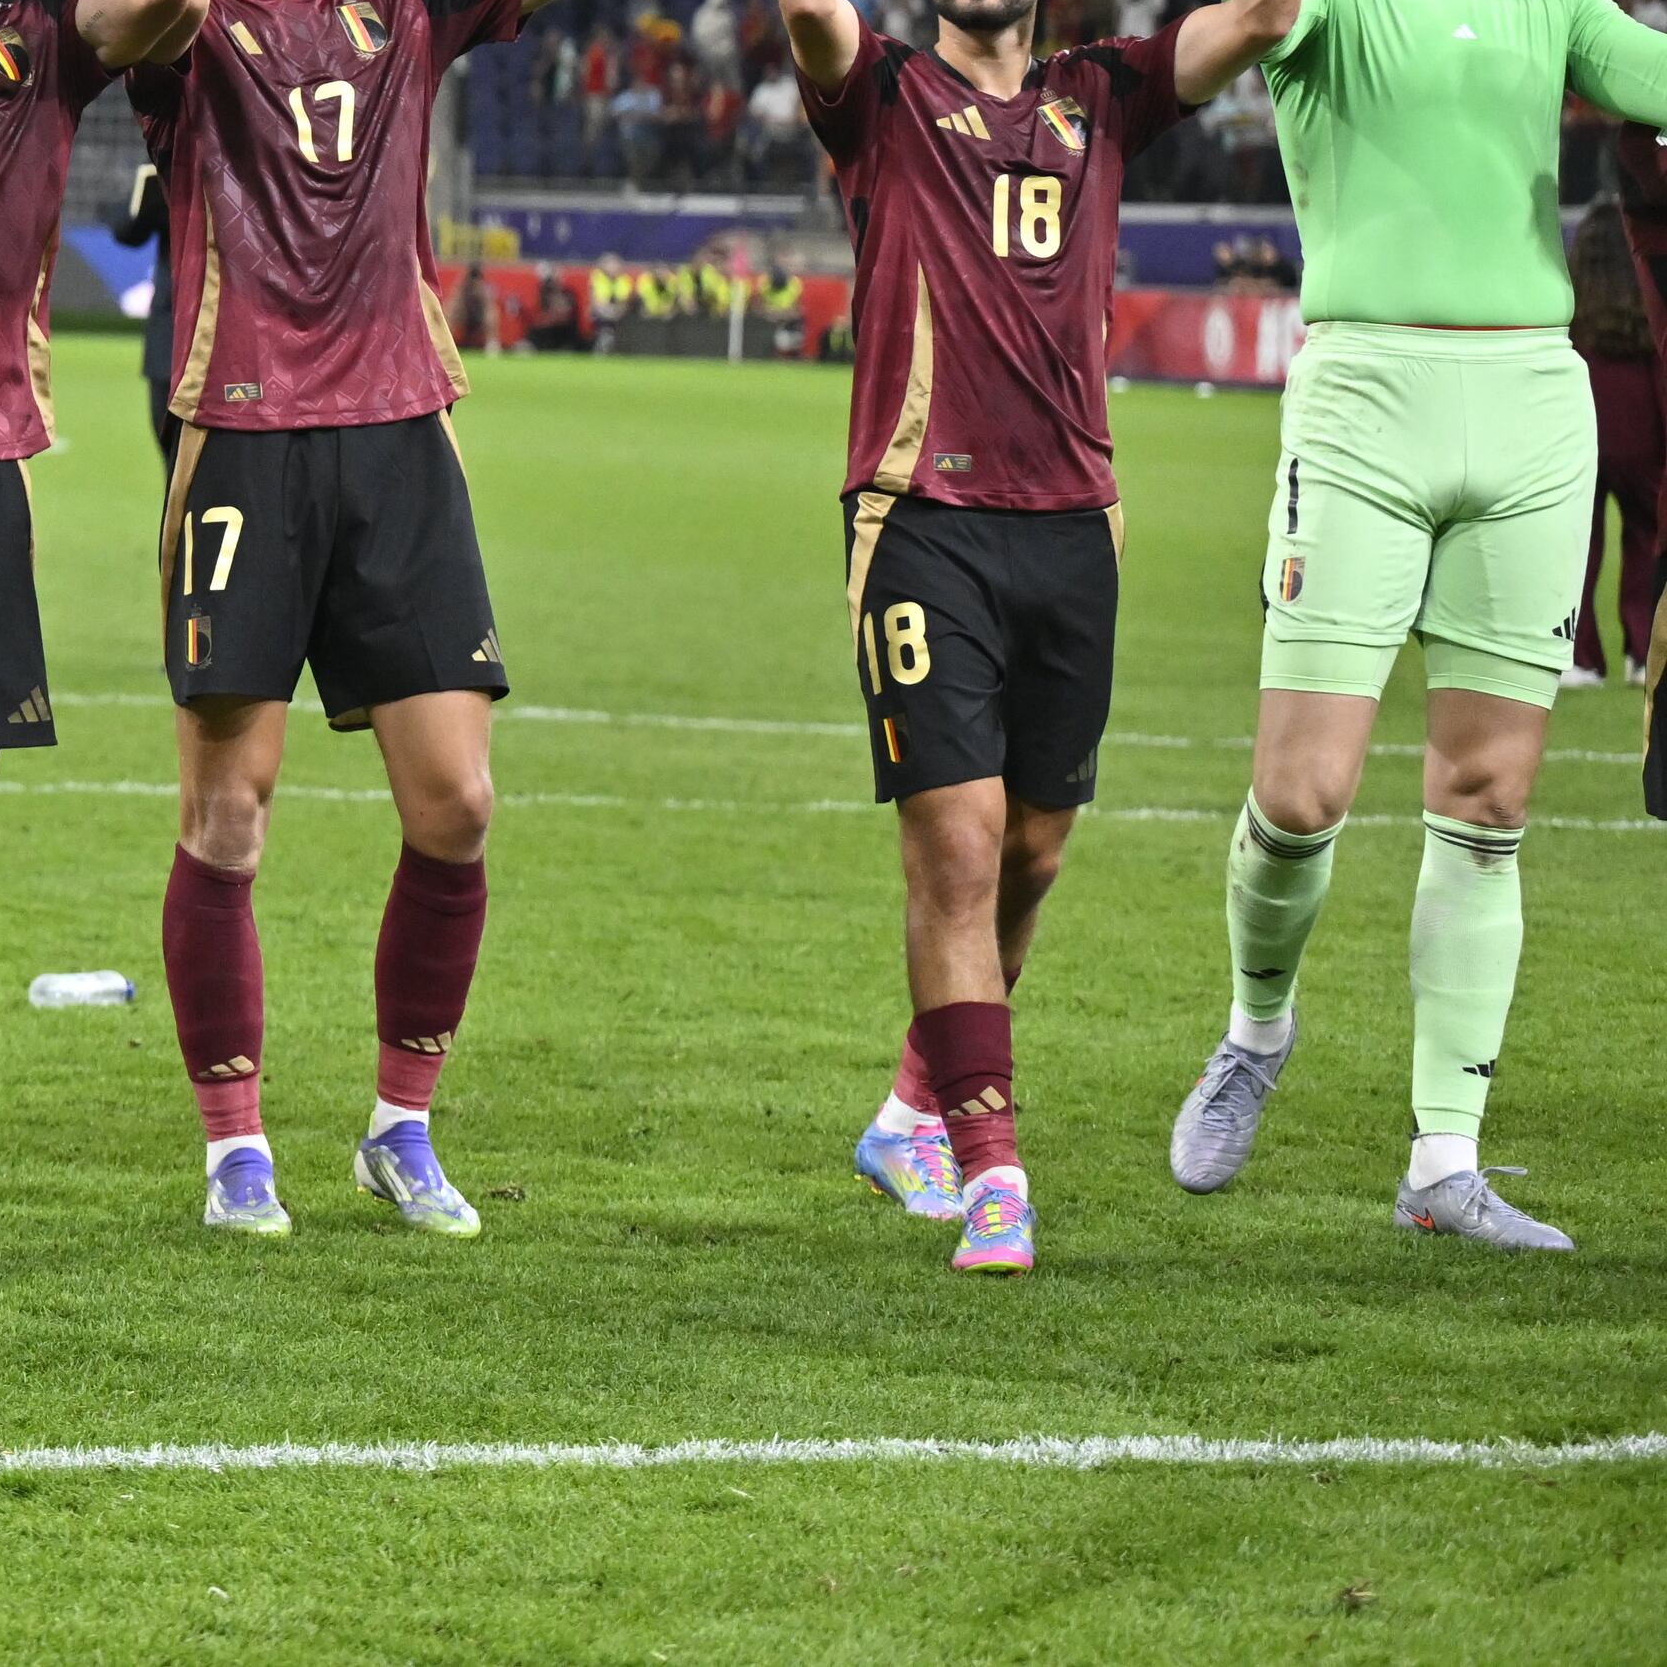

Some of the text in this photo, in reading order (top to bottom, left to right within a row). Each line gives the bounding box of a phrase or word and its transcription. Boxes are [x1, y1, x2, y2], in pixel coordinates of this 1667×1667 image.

[290, 80, 355, 163] 17
[992, 175, 1062, 259] 18
[184, 506, 243, 596] 17
[863, 602, 931, 695] 18
